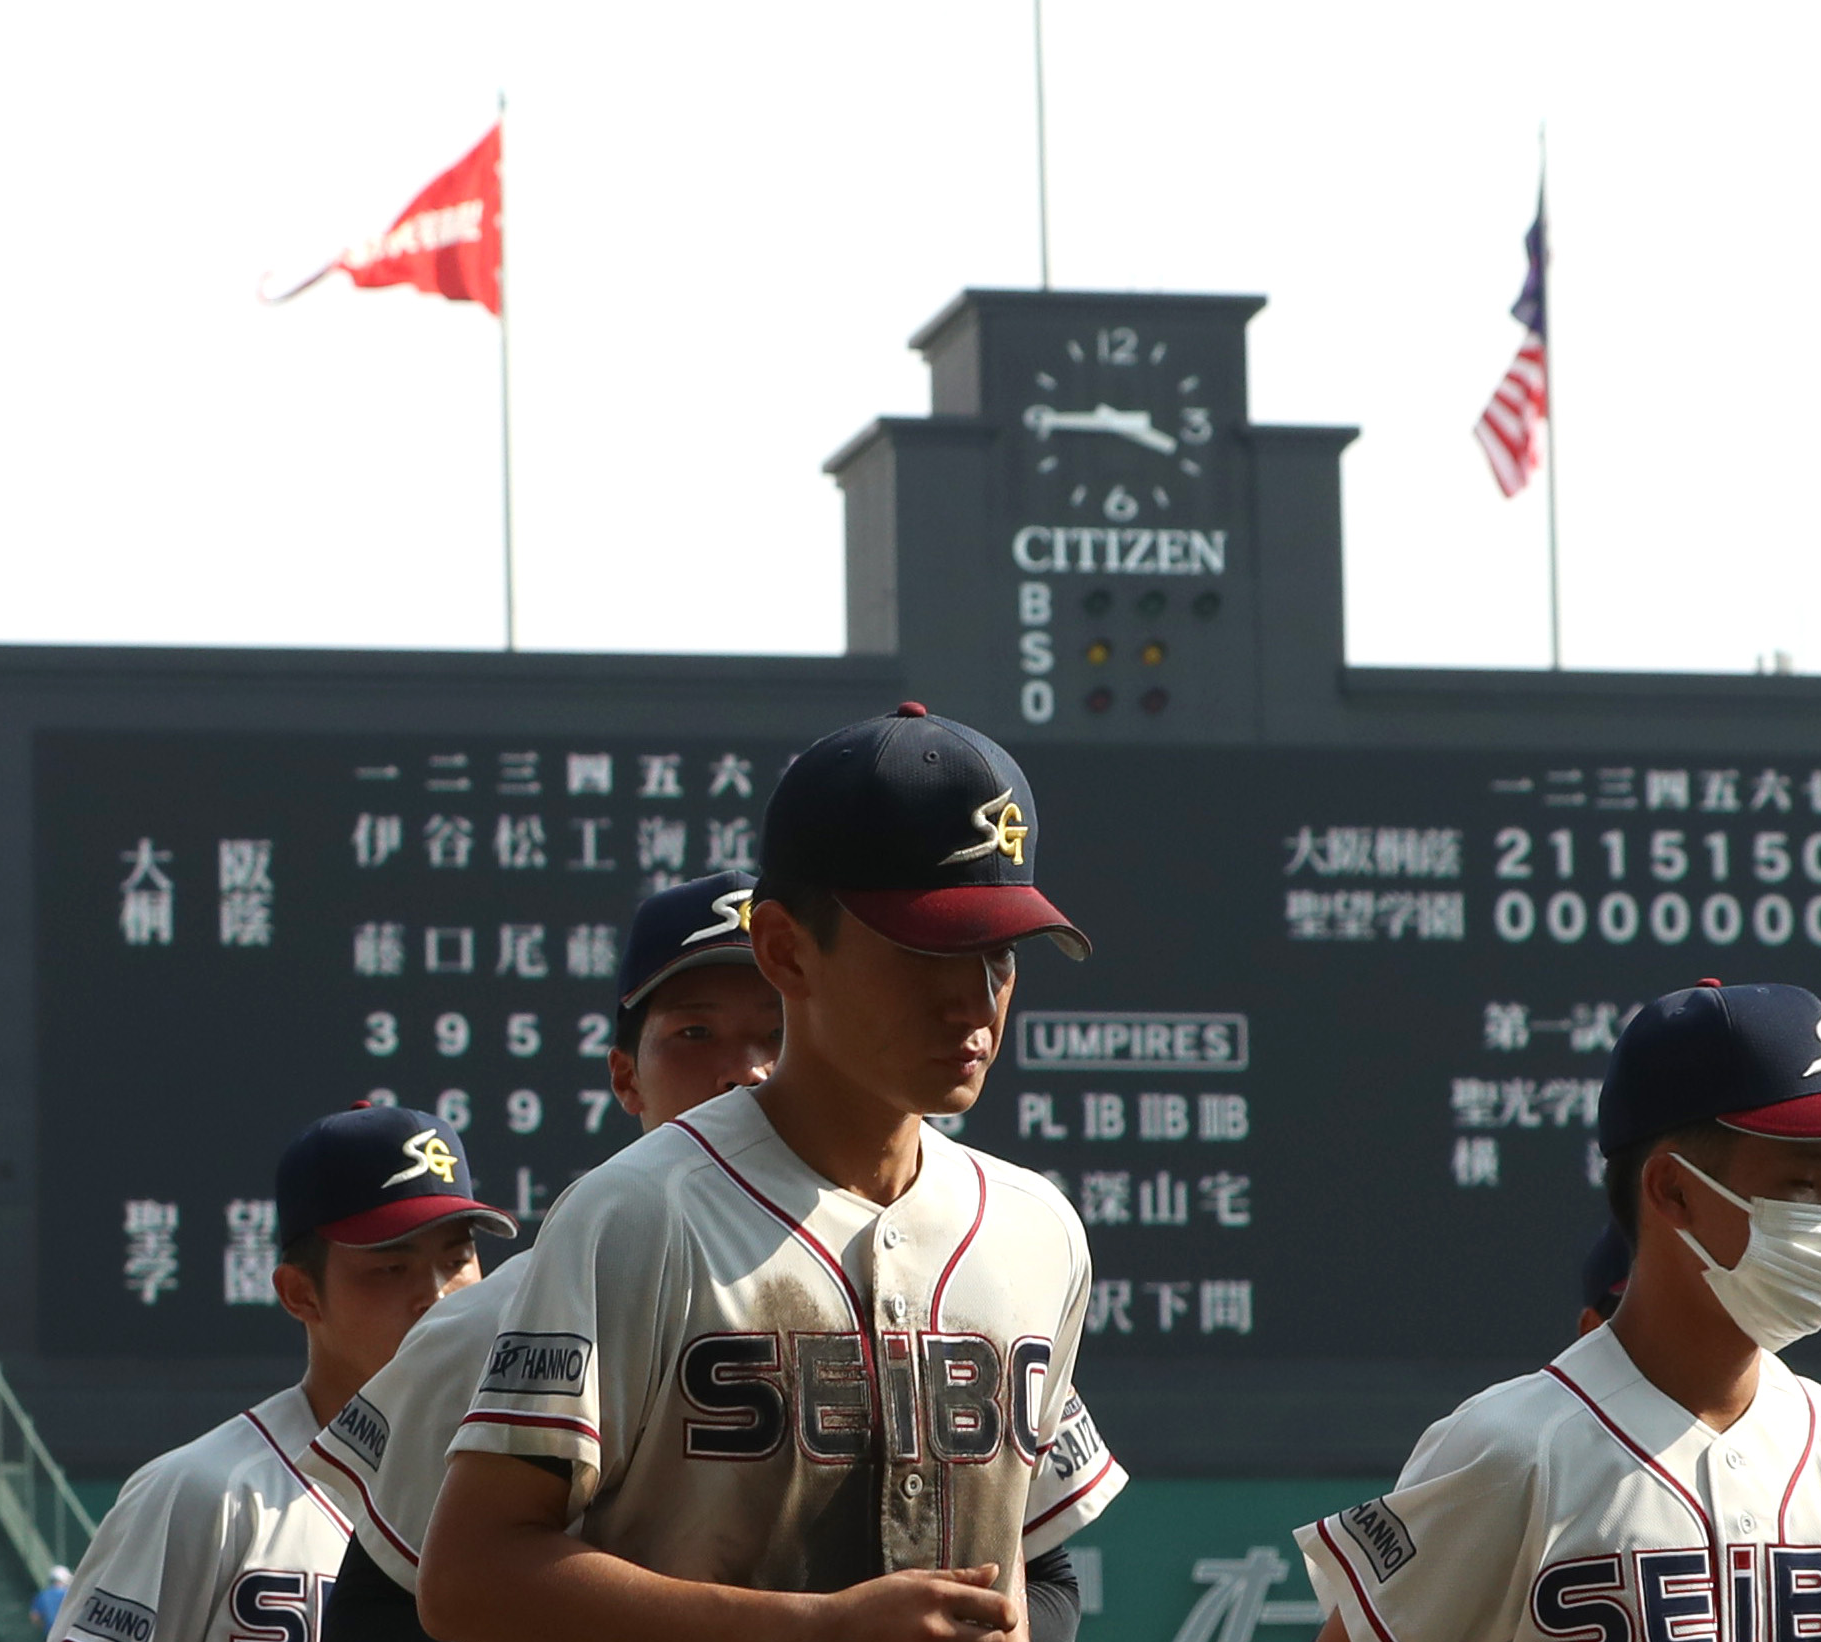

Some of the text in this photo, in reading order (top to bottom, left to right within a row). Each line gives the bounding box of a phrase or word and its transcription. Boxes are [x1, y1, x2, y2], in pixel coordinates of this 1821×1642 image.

[1096, 326, 1139, 366] 12
[1182, 406, 1213, 445] 3
[1103, 484, 1140, 522] 6
[1011, 524, 1227, 576] CITIZEN
[1017, 580, 1054, 627] B
[1019, 629, 1055, 675] S
[1033, 1022, 1231, 1062] UMPIRES
[520, 1348, 583, 1382] HANNO
[87, 1600, 152, 1642] HANNO
